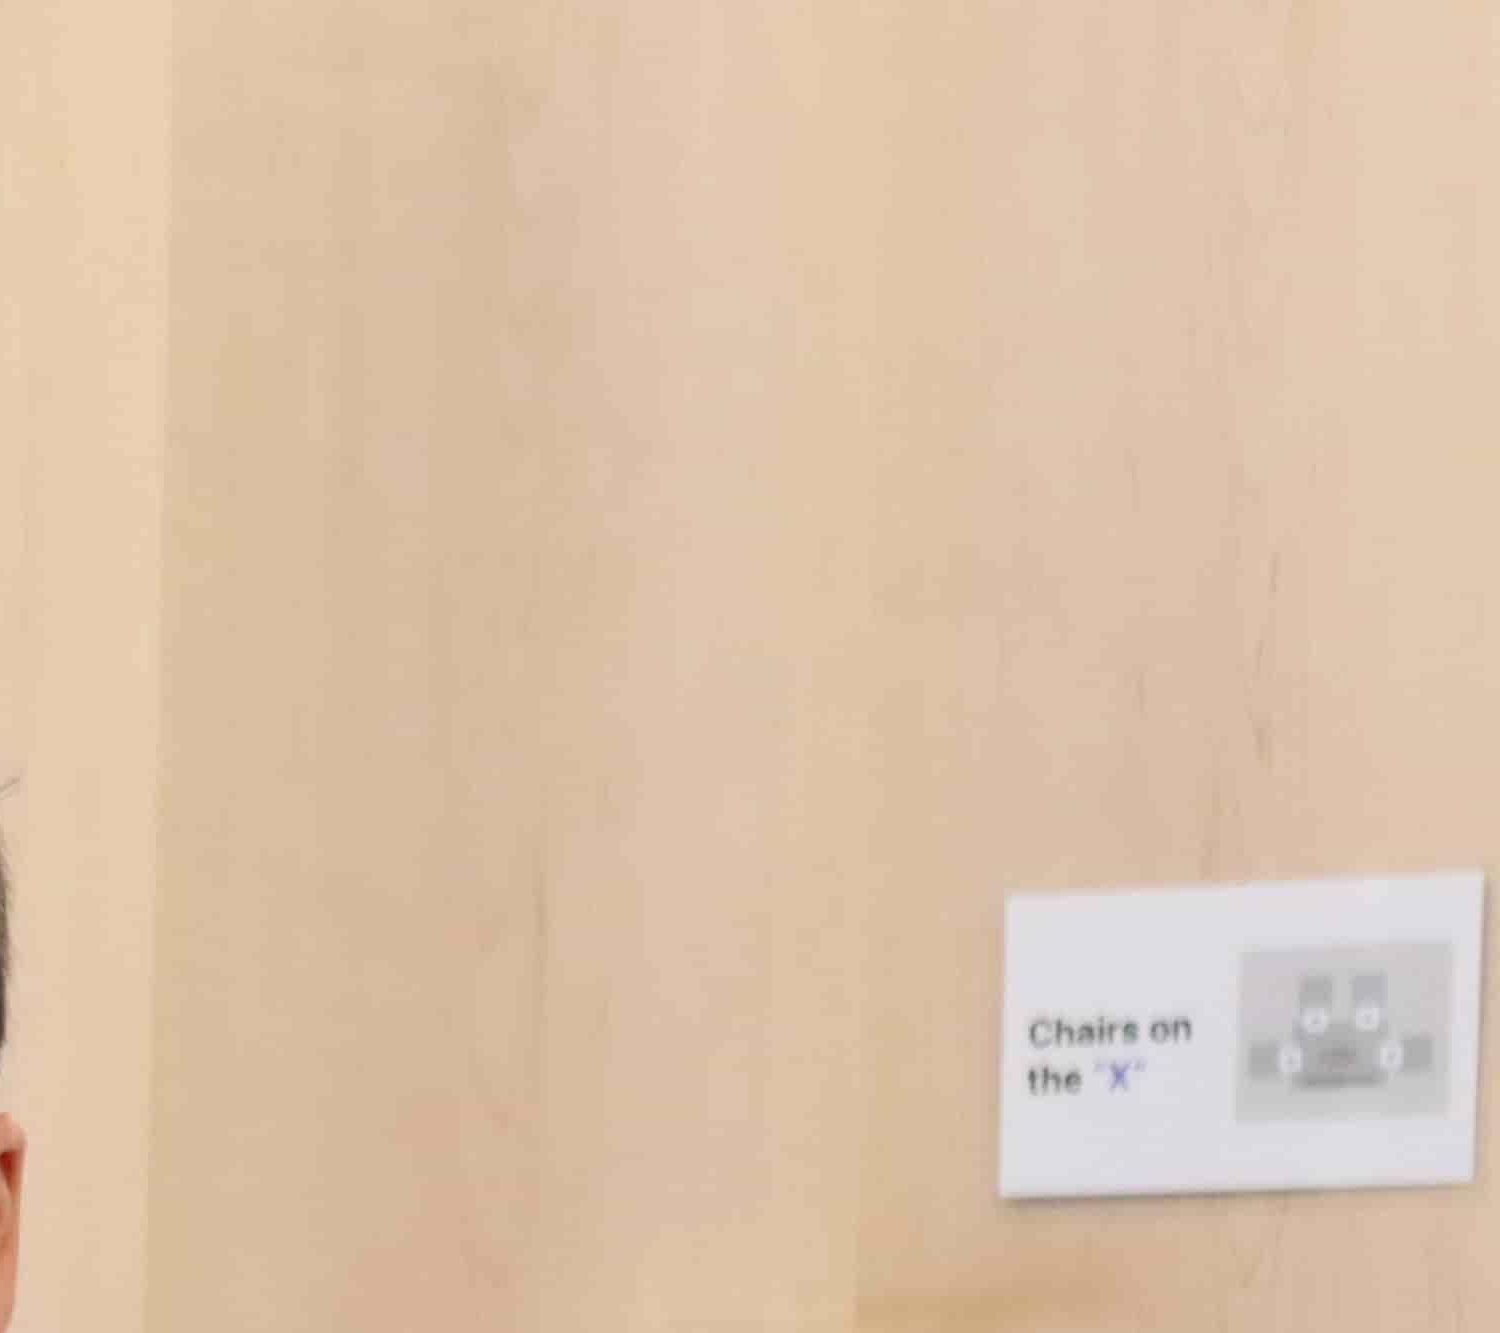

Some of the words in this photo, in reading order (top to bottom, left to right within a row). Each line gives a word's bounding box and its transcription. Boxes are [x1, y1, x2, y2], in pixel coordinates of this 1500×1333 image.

[1029, 1015, 1138, 1048] Chairs
[1150, 1015, 1192, 1043] on
[1028, 1065, 1082, 1095] the
[1094, 1061, 1146, 1091] "X"
